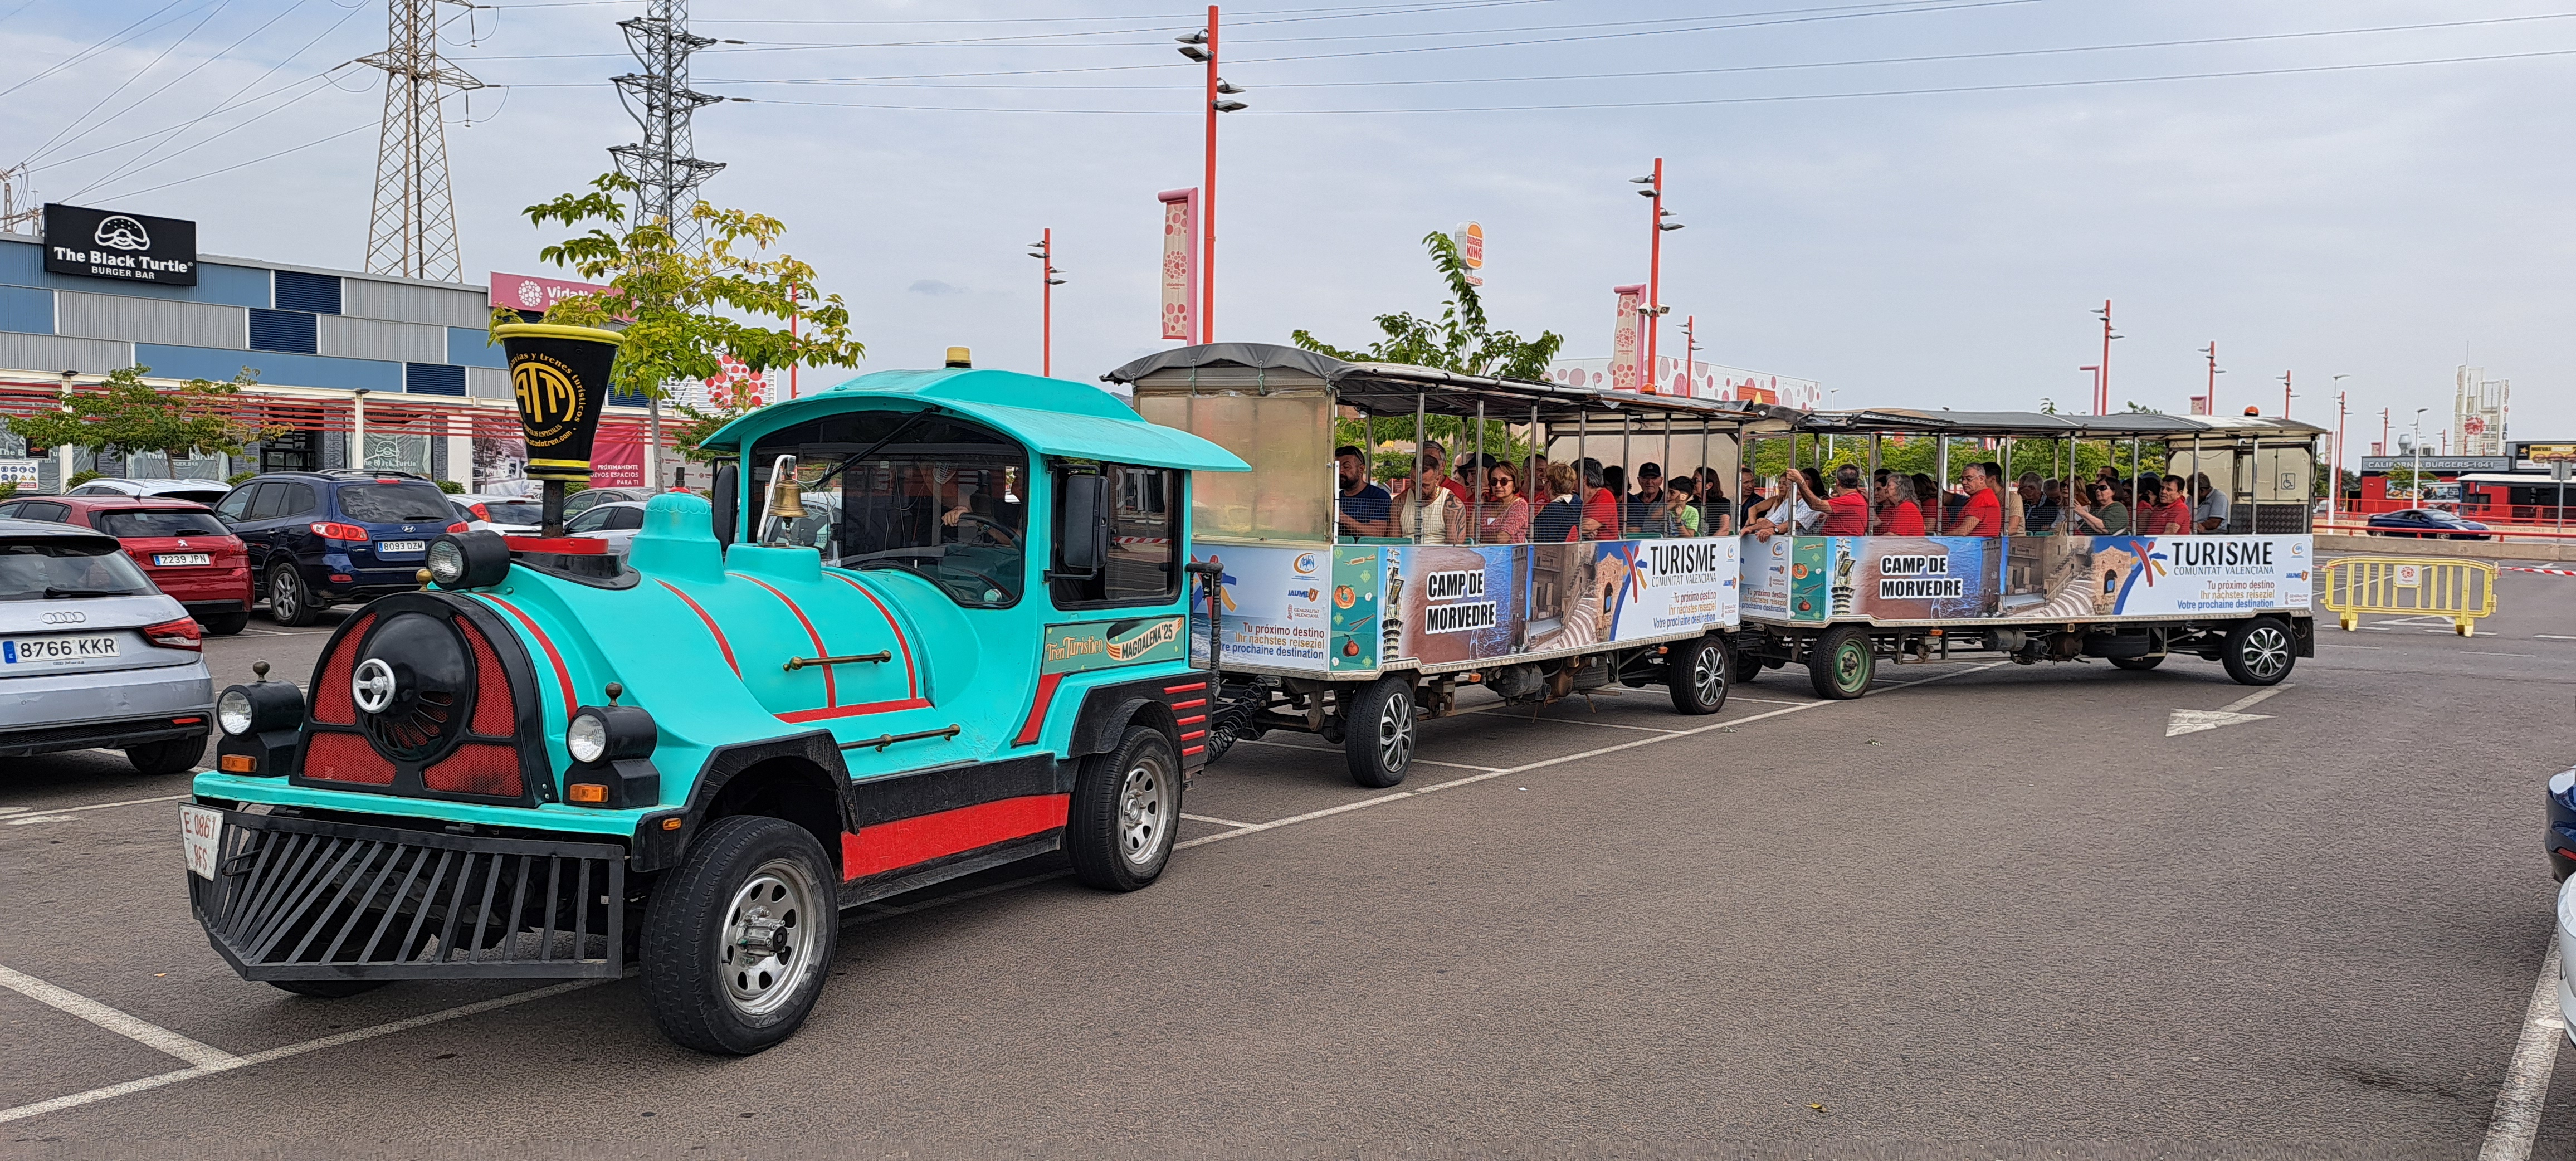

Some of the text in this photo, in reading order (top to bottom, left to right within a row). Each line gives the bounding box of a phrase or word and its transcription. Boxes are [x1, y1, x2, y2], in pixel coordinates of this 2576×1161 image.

[54, 247, 187, 272] The Black Turtle
[1467, 245, 1482, 260] KING
[91, 266, 154, 279] BURGER BAR
[540, 353, 572, 374] trenes
[572, 374, 587, 422] turísticos
[1650, 544, 1716, 575] TURISME
[2172, 542, 2273, 565] TURISME
[1882, 557, 1946, 573] CAMP DE
[2174, 565, 2274, 575] COMUNITAT VALENCIANA
[1428, 572, 1483, 597] CAMP DE
[1652, 574, 1684, 587] COMUNITAT
[1686, 573, 1716, 584] VALENCIANA
[2207, 580, 2275, 591] Tu próximo destino
[1288, 590, 1309, 598] JAUME
[1674, 592, 1679, 603] Tu
[1700, 589, 1716, 601] destino
[1881, 580, 1961, 597] MORVEDRE
[2201, 590, 2209, 599] Ihr
[2246, 589, 2275, 599] reiseziel
[2177, 599, 2274, 611] Votre prochaine destination
[1427, 603, 1495, 631] MORVEDRE
[1653, 617, 1666, 629] Votre
[1243, 622, 1325, 638] Tu próximo destino
[20, 638, 115, 658] 8766 KKR
[1046, 643, 1065, 662] Tren
[1122, 626, 1162, 659] MAGDALENA
[1235, 632, 1247, 642] Ihr
[1289, 637, 1325, 649] reiseziel
[1220, 643, 1324, 660] tre prochaine destination
[184, 812, 216, 840] E 0861
